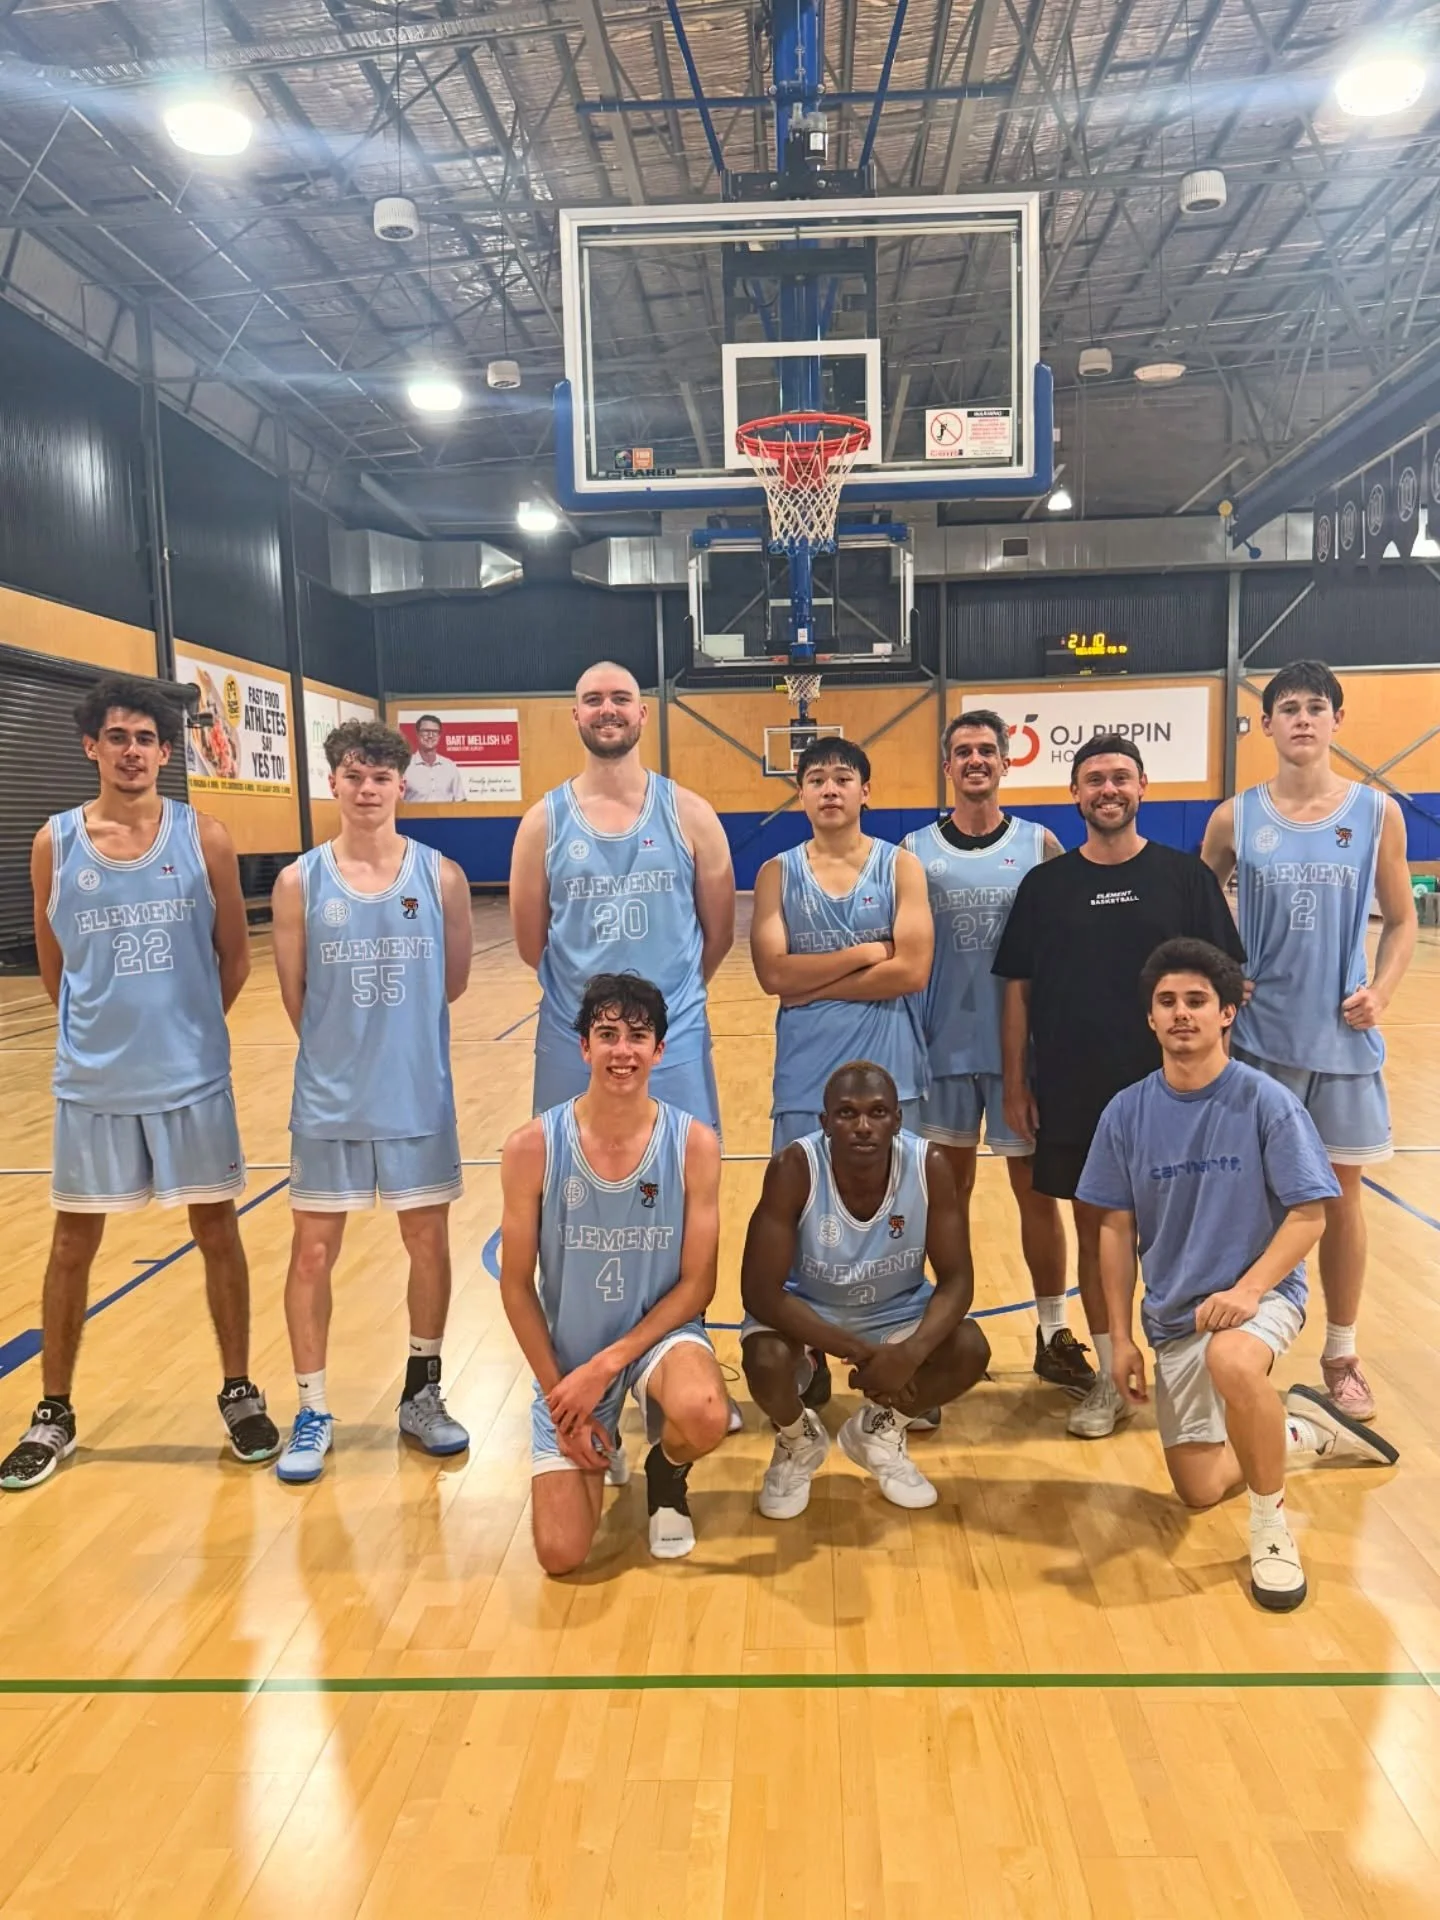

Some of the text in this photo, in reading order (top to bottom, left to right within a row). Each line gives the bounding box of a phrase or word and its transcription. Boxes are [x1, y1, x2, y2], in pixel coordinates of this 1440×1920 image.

[248, 686, 263, 706] FAST
[264, 690, 280, 710] FOOD
[244, 704, 287, 737] ATHLETES
[1050, 725, 1083, 746] OJ
[262, 735, 273, 752] SAY
[446, 734, 513, 745] BART MELLISH MP
[251, 751, 270, 779] YES
[270, 754, 286, 780] TO!
[1051, 750, 1075, 763] HO
[562, 869, 676, 901] ELEMENT
[934, 886, 1017, 914] LEMEN
[1096, 890, 1132, 900] ELEMENT
[1090, 895, 1140, 906] BASKETBALL
[1290, 889, 1316, 931] 2
[74, 898, 196, 935] ELEMENT
[594, 899, 648, 944] 20
[952, 911, 1004, 953] 27
[112, 928, 174, 976] 22
[320, 936, 434, 964] ELEMENT
[351, 964, 406, 1008] 55
[595, 1257, 625, 1302] 4
[800, 1247, 925, 1285] ELEMENT
